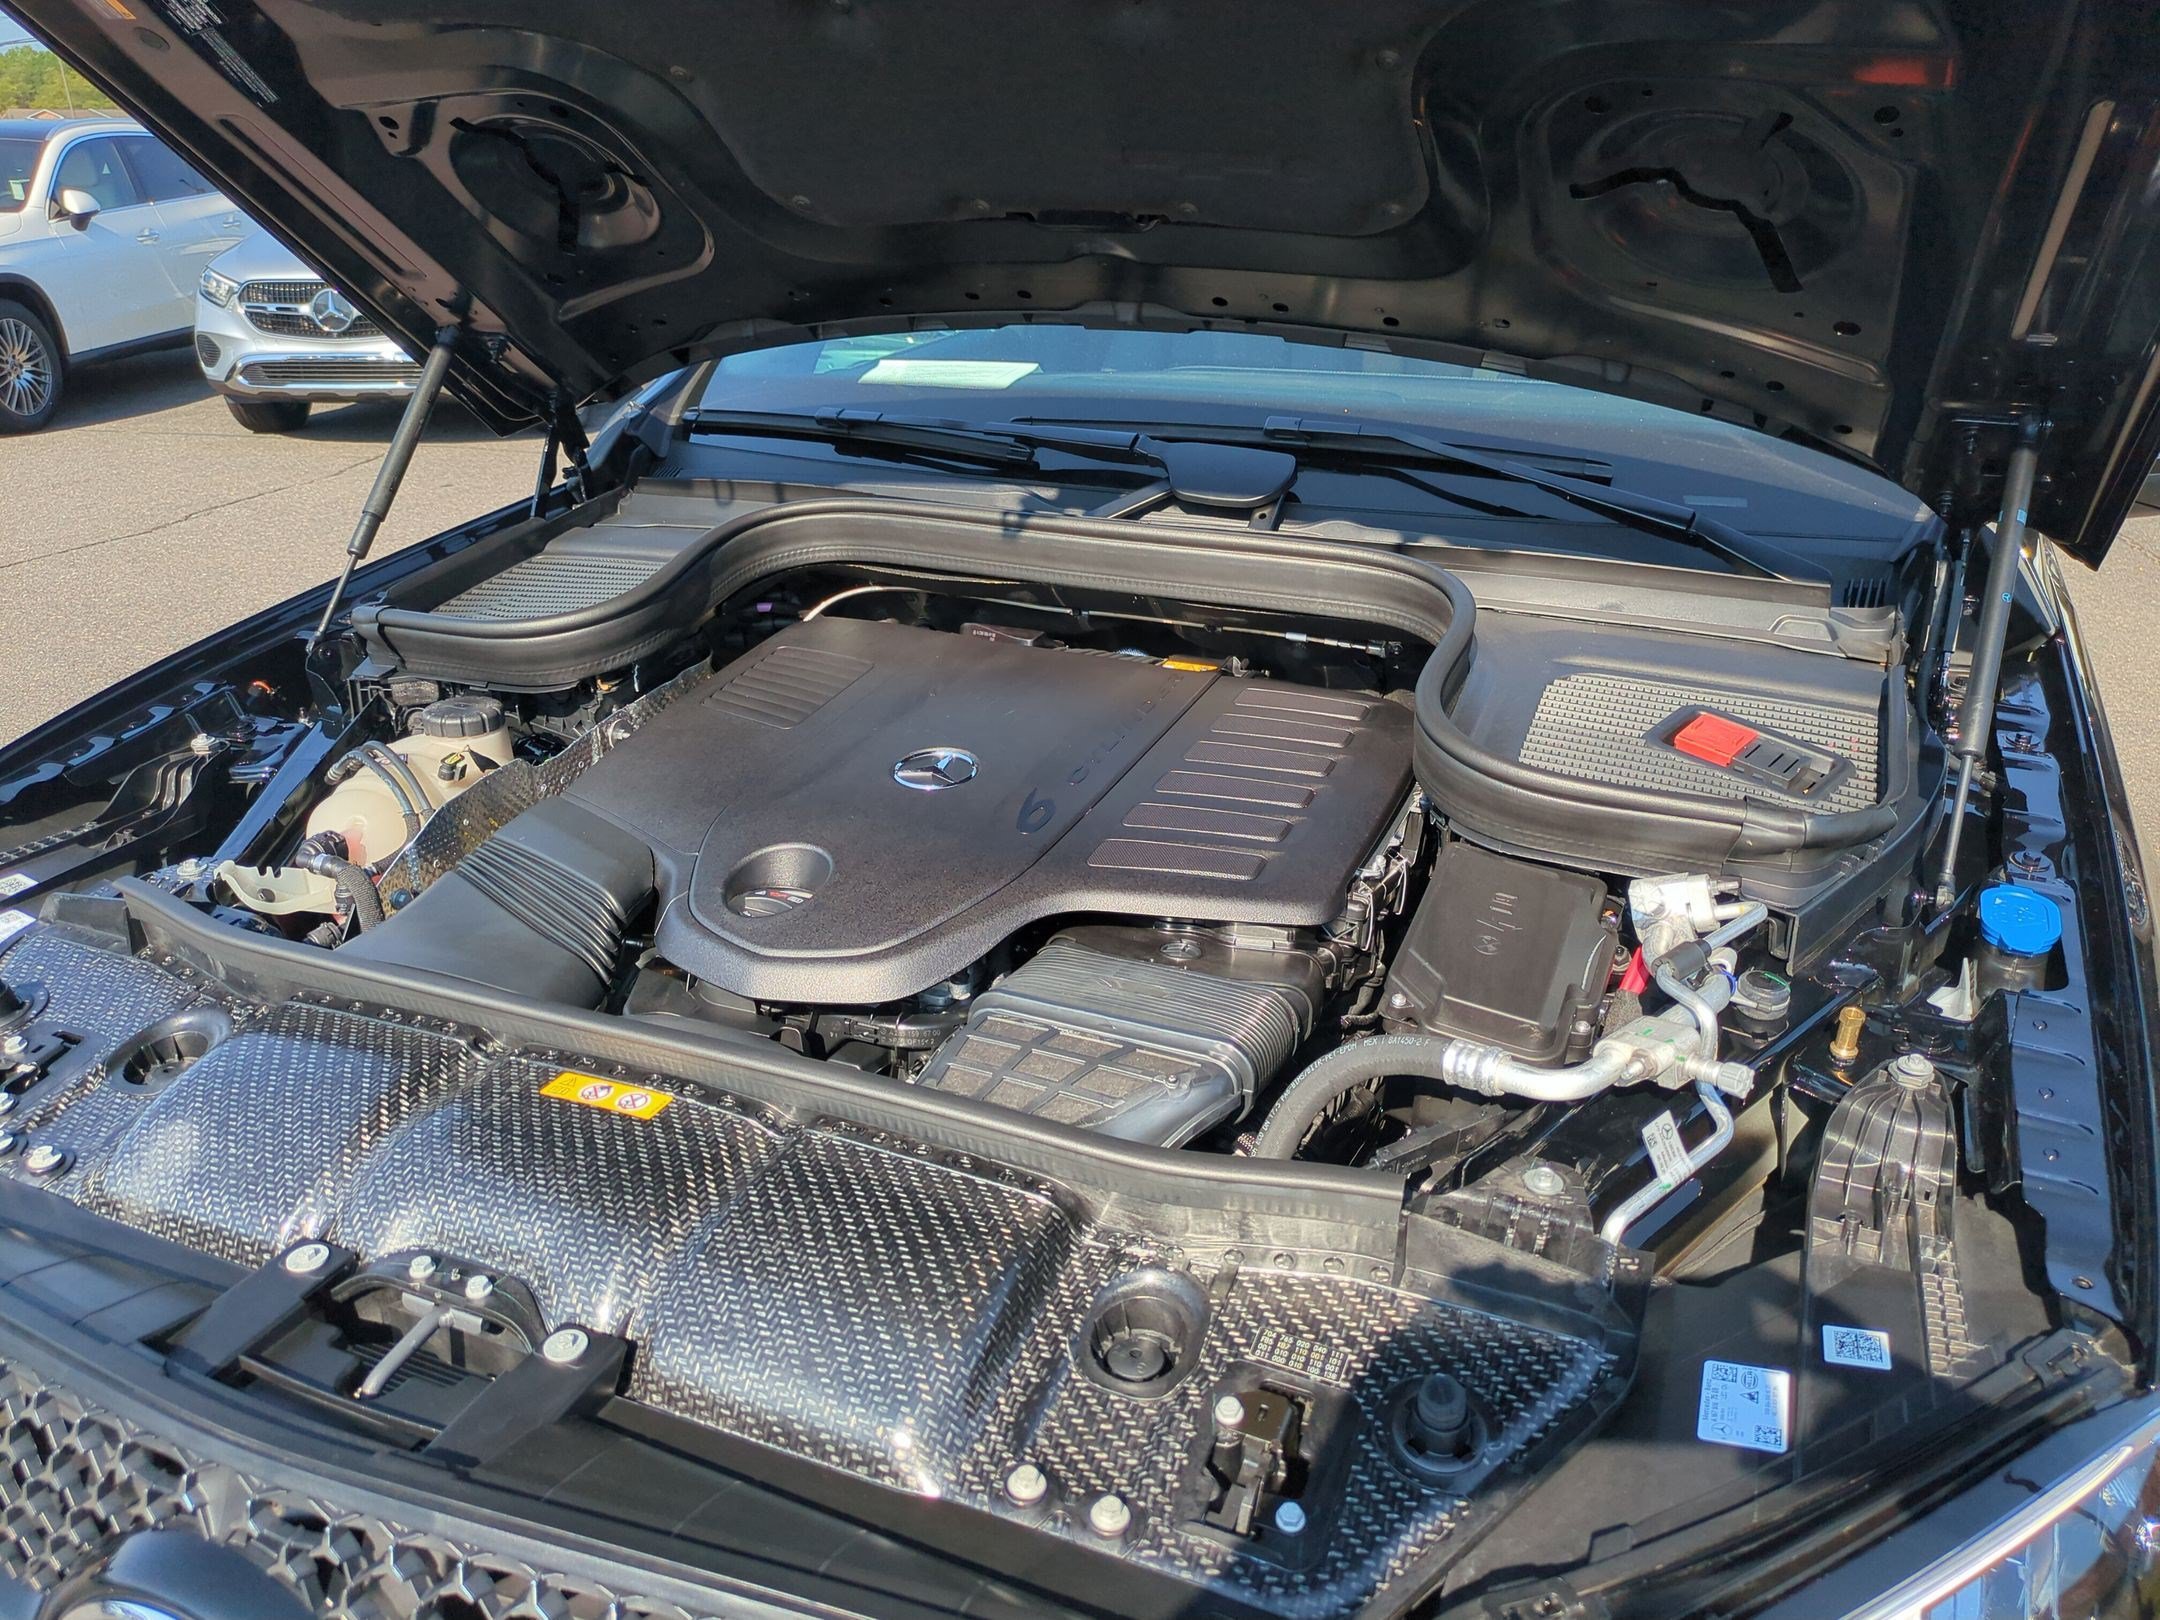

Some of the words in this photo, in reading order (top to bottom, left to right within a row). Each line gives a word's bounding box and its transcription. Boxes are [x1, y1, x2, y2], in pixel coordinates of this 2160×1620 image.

[1016, 786, 1057, 836] 6
[1263, 1120, 1270, 1131] DN
[1258, 1343, 1271, 1352] 001
[1274, 1348, 1288, 1357] 010
[1291, 1353, 1305, 1362] 010
[1325, 1364, 1339, 1373] 001
[1295, 1347, 1308, 1355] 110
[1329, 1358, 1341, 1366] 101
[1296, 1340, 1310, 1348] 020
[1313, 1345, 1327, 1354] 040
[1331, 1351, 1343, 1359] 111
[1255, 1350, 1269, 1359] 011
[1272, 1356, 1286, 1364] 000
[1289, 1361, 1303, 1369] 010
